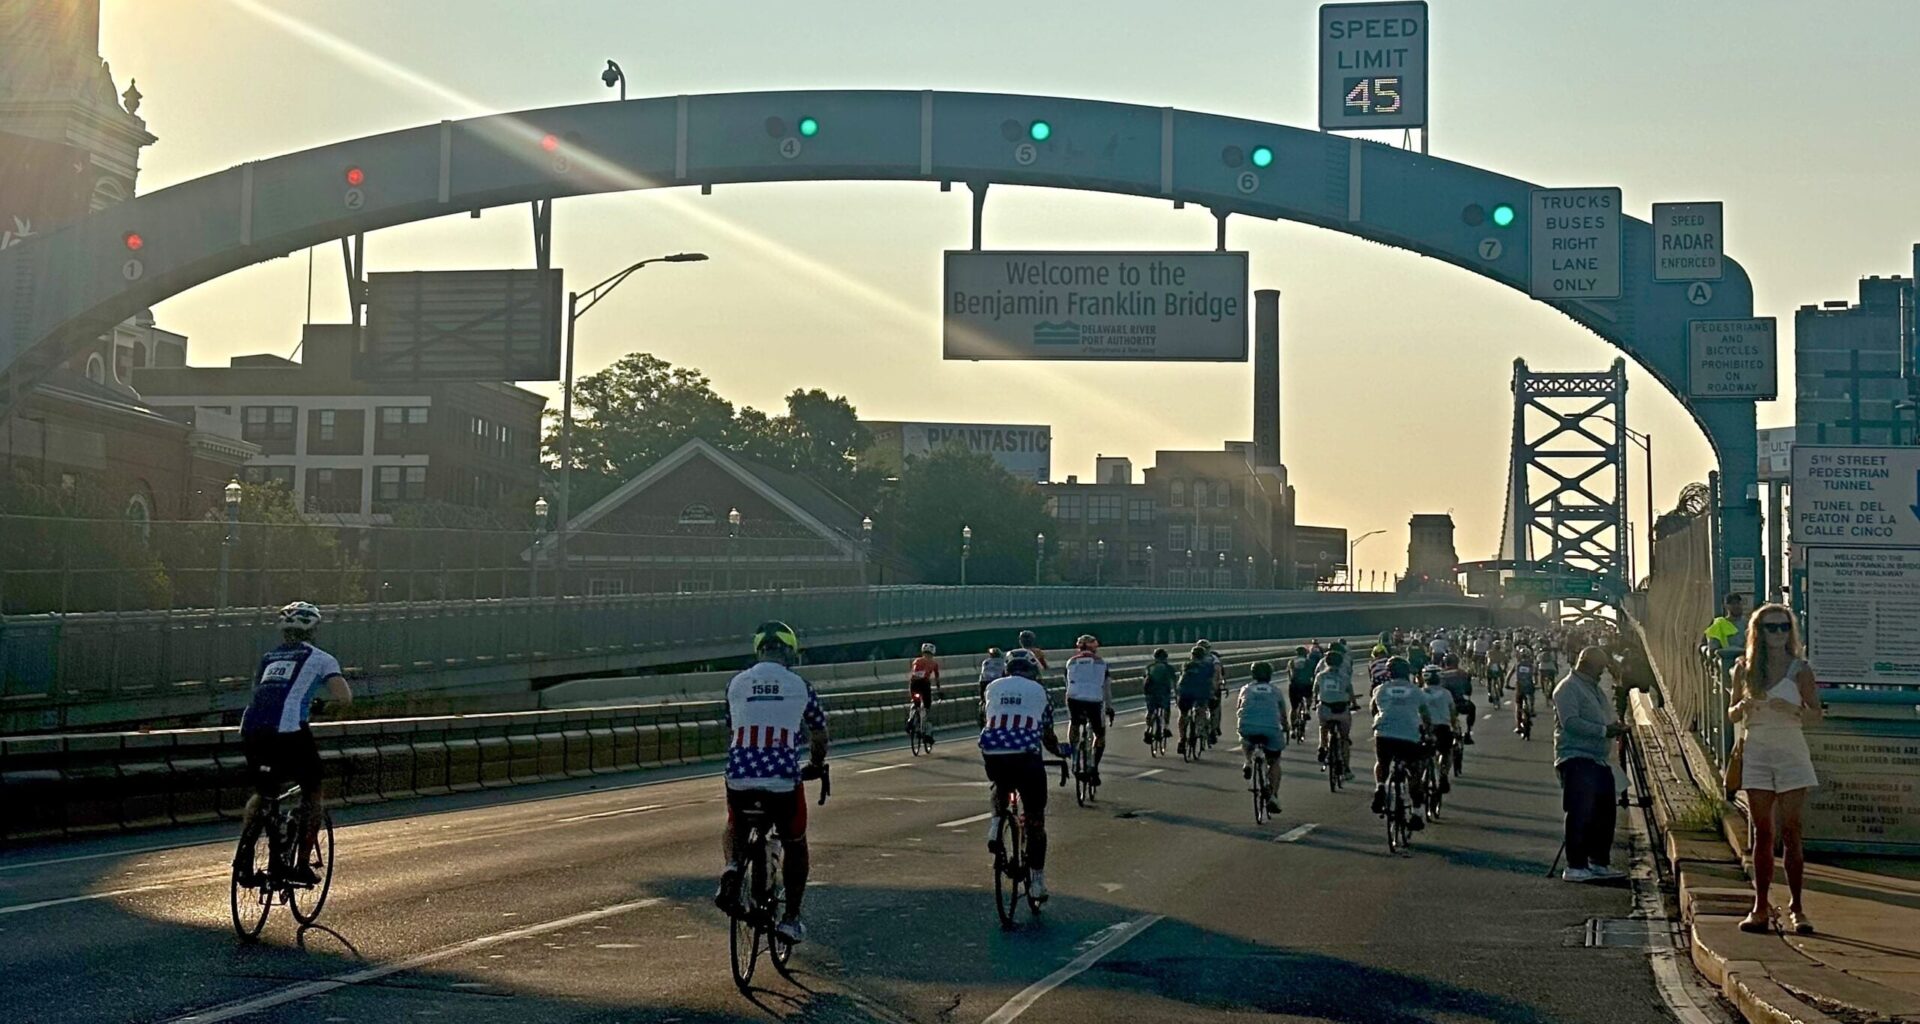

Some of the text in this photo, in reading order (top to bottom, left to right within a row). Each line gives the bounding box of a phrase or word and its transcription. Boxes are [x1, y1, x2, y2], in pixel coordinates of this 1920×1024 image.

[1329, 18, 1418, 39] SPEED
[1338, 48, 1408, 69] LIMIT
[1345, 78, 1401, 113] 45
[782, 139, 795, 155] 4
[1019, 145, 1032, 163] 5
[555, 155, 568, 172] 3
[1241, 173, 1255, 191] 6
[347, 191, 360, 207] 2
[1541, 196, 1611, 209] TRUCKS
[1546, 216, 1605, 230] BUSES
[1671, 215, 1704, 226] SPEED
[1552, 237, 1598, 250] RIGHT
[1662, 234, 1714, 250] RADAR
[1483, 240, 1497, 258] 7
[1552, 258, 1598, 270] LANE
[1661, 257, 1715, 268] ENFORCED
[1006, 261, 1186, 286] Welcome to the
[1553, 278, 1597, 291] ONLY
[1691, 284, 1708, 302] A
[954, 291, 1237, 322] Benjamin Franklin Bridge
[1081, 324, 1156, 335] DELAWARE RIVER
[1694, 322, 1769, 333] PEDESTRIANS
[1081, 335, 1156, 346] PORT AUTHORITY
[1722, 334, 1743, 344] AND
[1706, 345, 1759, 356] BICYCLES
[1701, 359, 1764, 370] PROHIBITED
[1725, 371, 1741, 380] ON
[1707, 382, 1758, 393] ROADWAY
[1811, 455, 1887, 466] 5TH STREET
[1808, 467, 1889, 478] PEDESTRIAN
[1823, 480, 1874, 490] TUNNEL
[1813, 501, 1885, 511] TUNEL DEL
[1801, 513, 1897, 524] PEATON DE LA
[1804, 526, 1893, 537] CALLE CINCO
[1888, 554, 1904, 562] THE
[1855, 561, 1895, 569] FRANKLIN
[1865, 569, 1904, 577] WALKWAY
[752, 685, 779, 694] 1568
